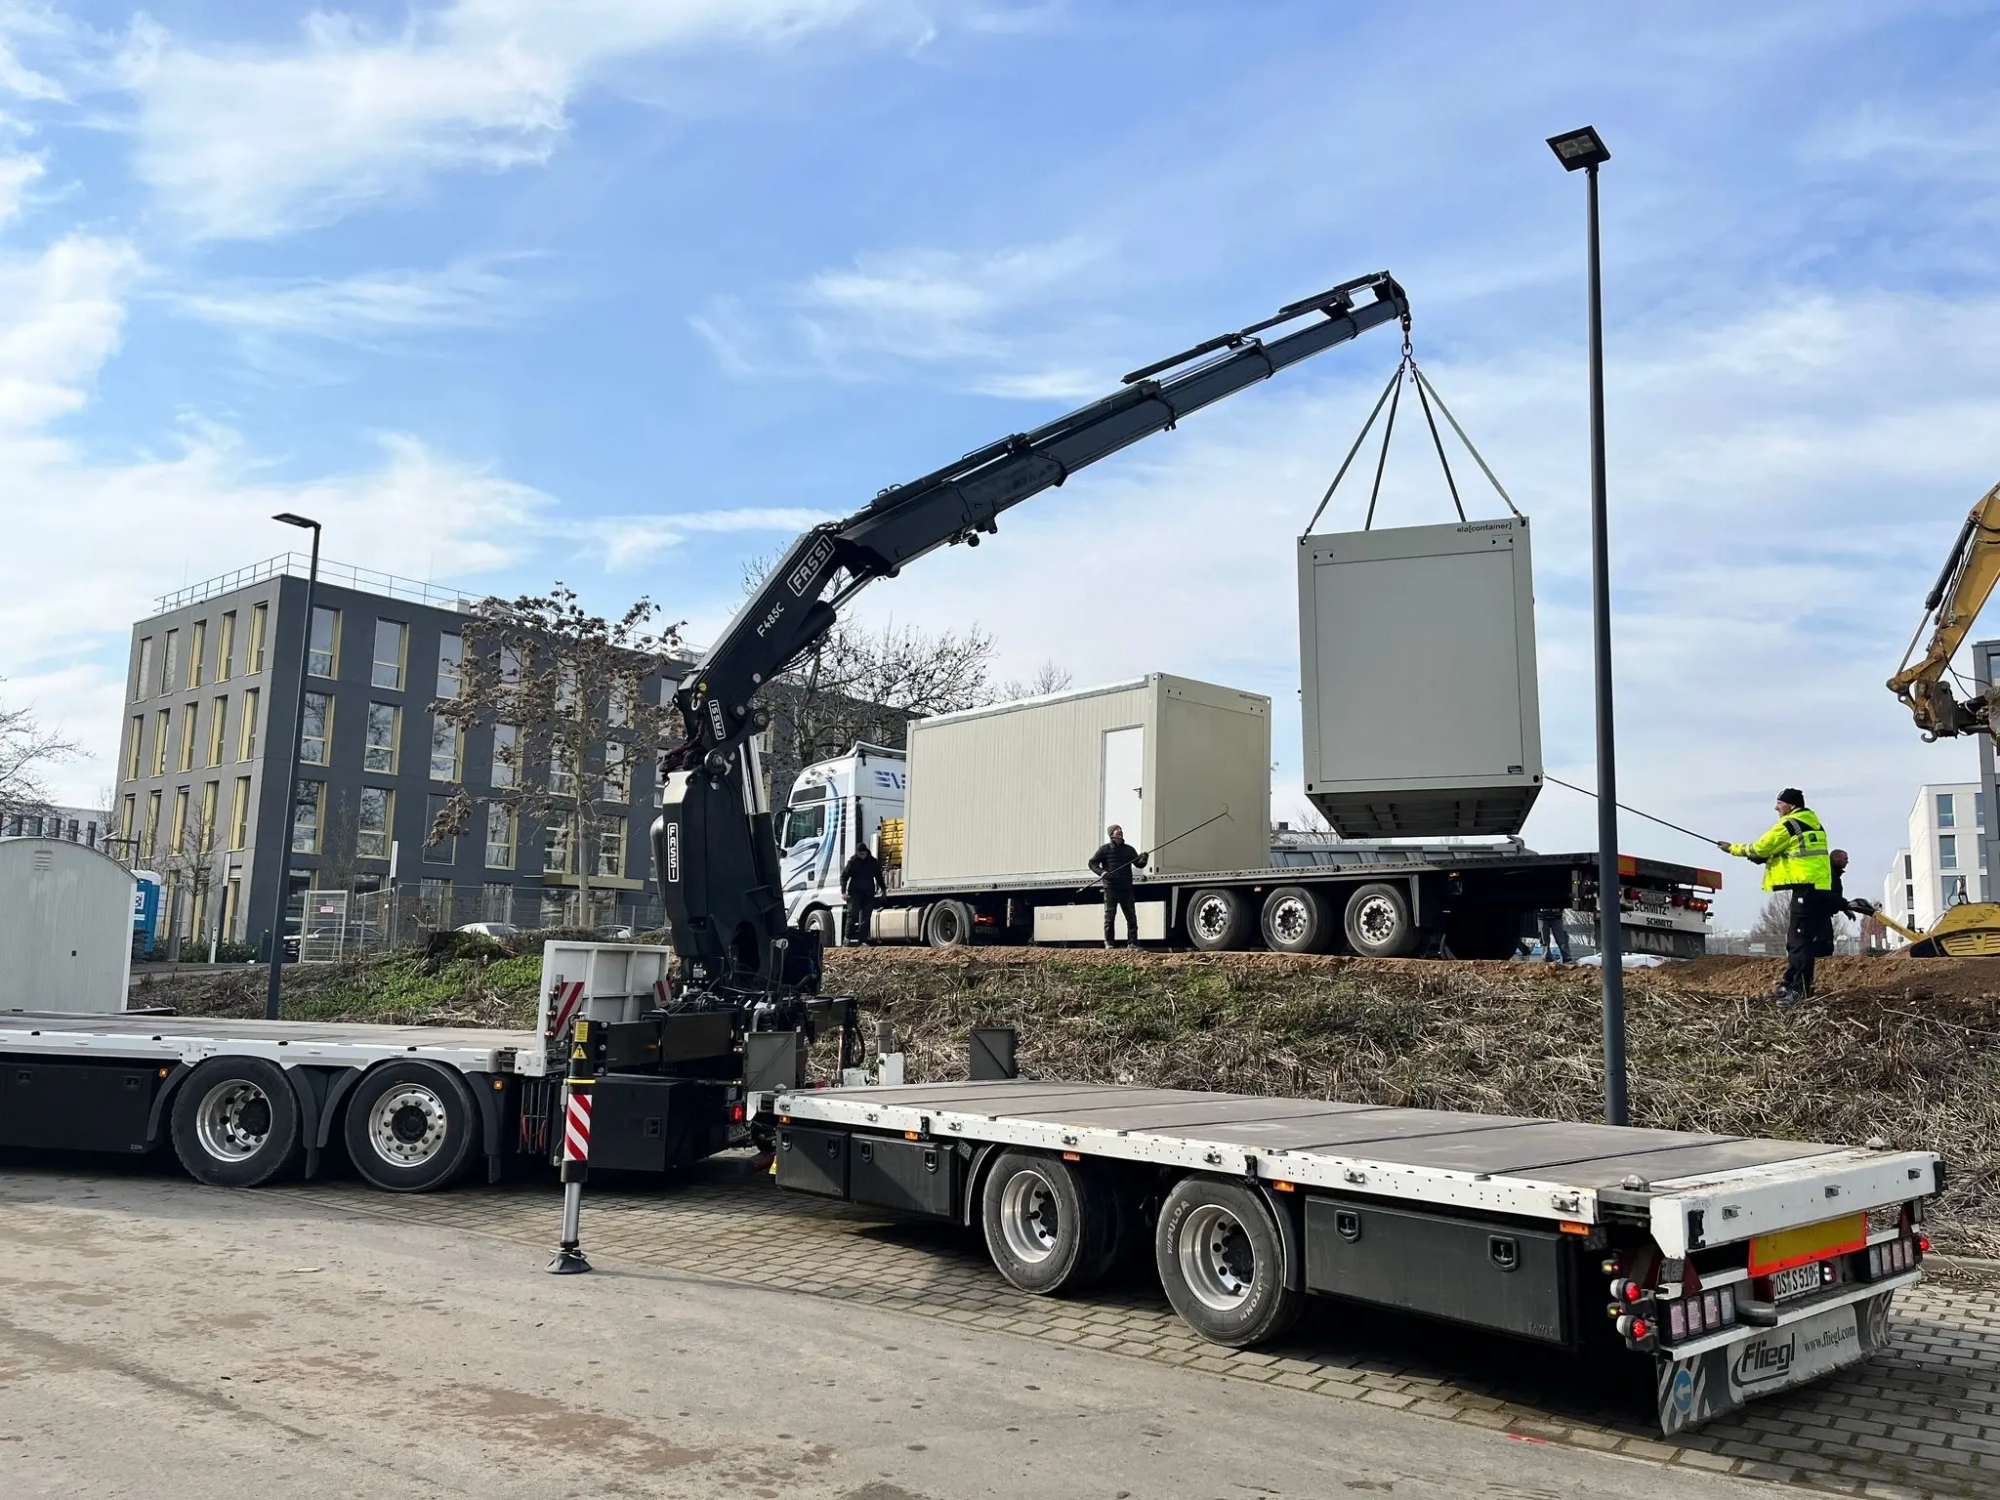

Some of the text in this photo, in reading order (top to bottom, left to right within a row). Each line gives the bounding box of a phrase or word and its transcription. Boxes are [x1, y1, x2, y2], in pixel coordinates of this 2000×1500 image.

[792, 541, 830, 590] FASSI
[756, 601, 785, 637] F485C
[710, 703, 724, 737] FASSI
[669, 825, 677, 879] FASSI
[1646, 917, 1673, 928] SCHMITZ
[1630, 930, 1674, 952] MAN
[1741, 1332, 1796, 1373] Fliegl
[1803, 1325, 1856, 1353] www.fliegl.com
